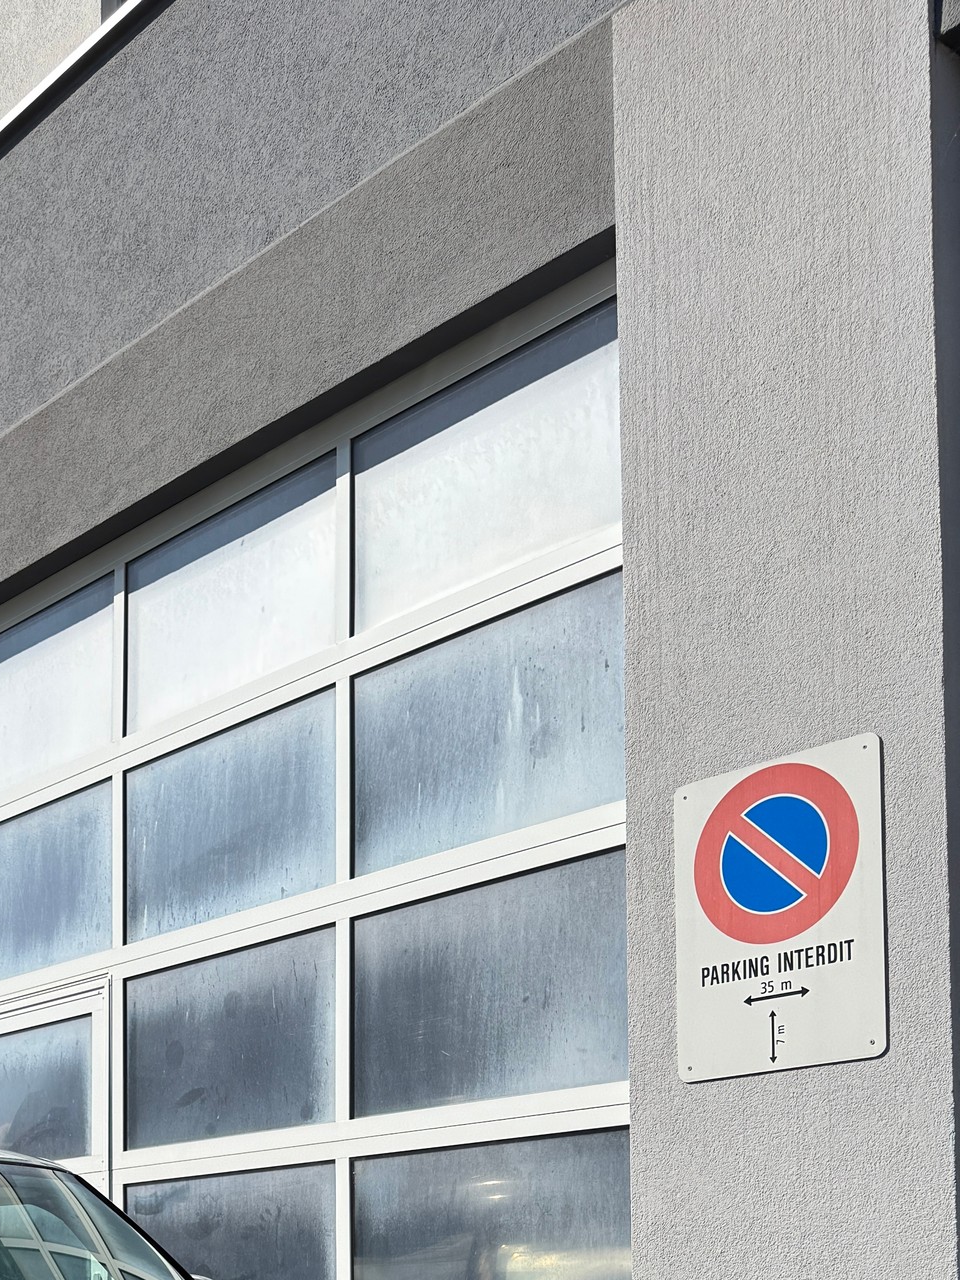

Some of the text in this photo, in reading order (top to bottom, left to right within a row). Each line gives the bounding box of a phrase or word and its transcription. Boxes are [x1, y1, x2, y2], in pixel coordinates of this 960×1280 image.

[701, 938, 854, 988] PARKING INTERDIT
[760, 979, 792, 995] 35 m
[777, 1024, 786, 1035] m
